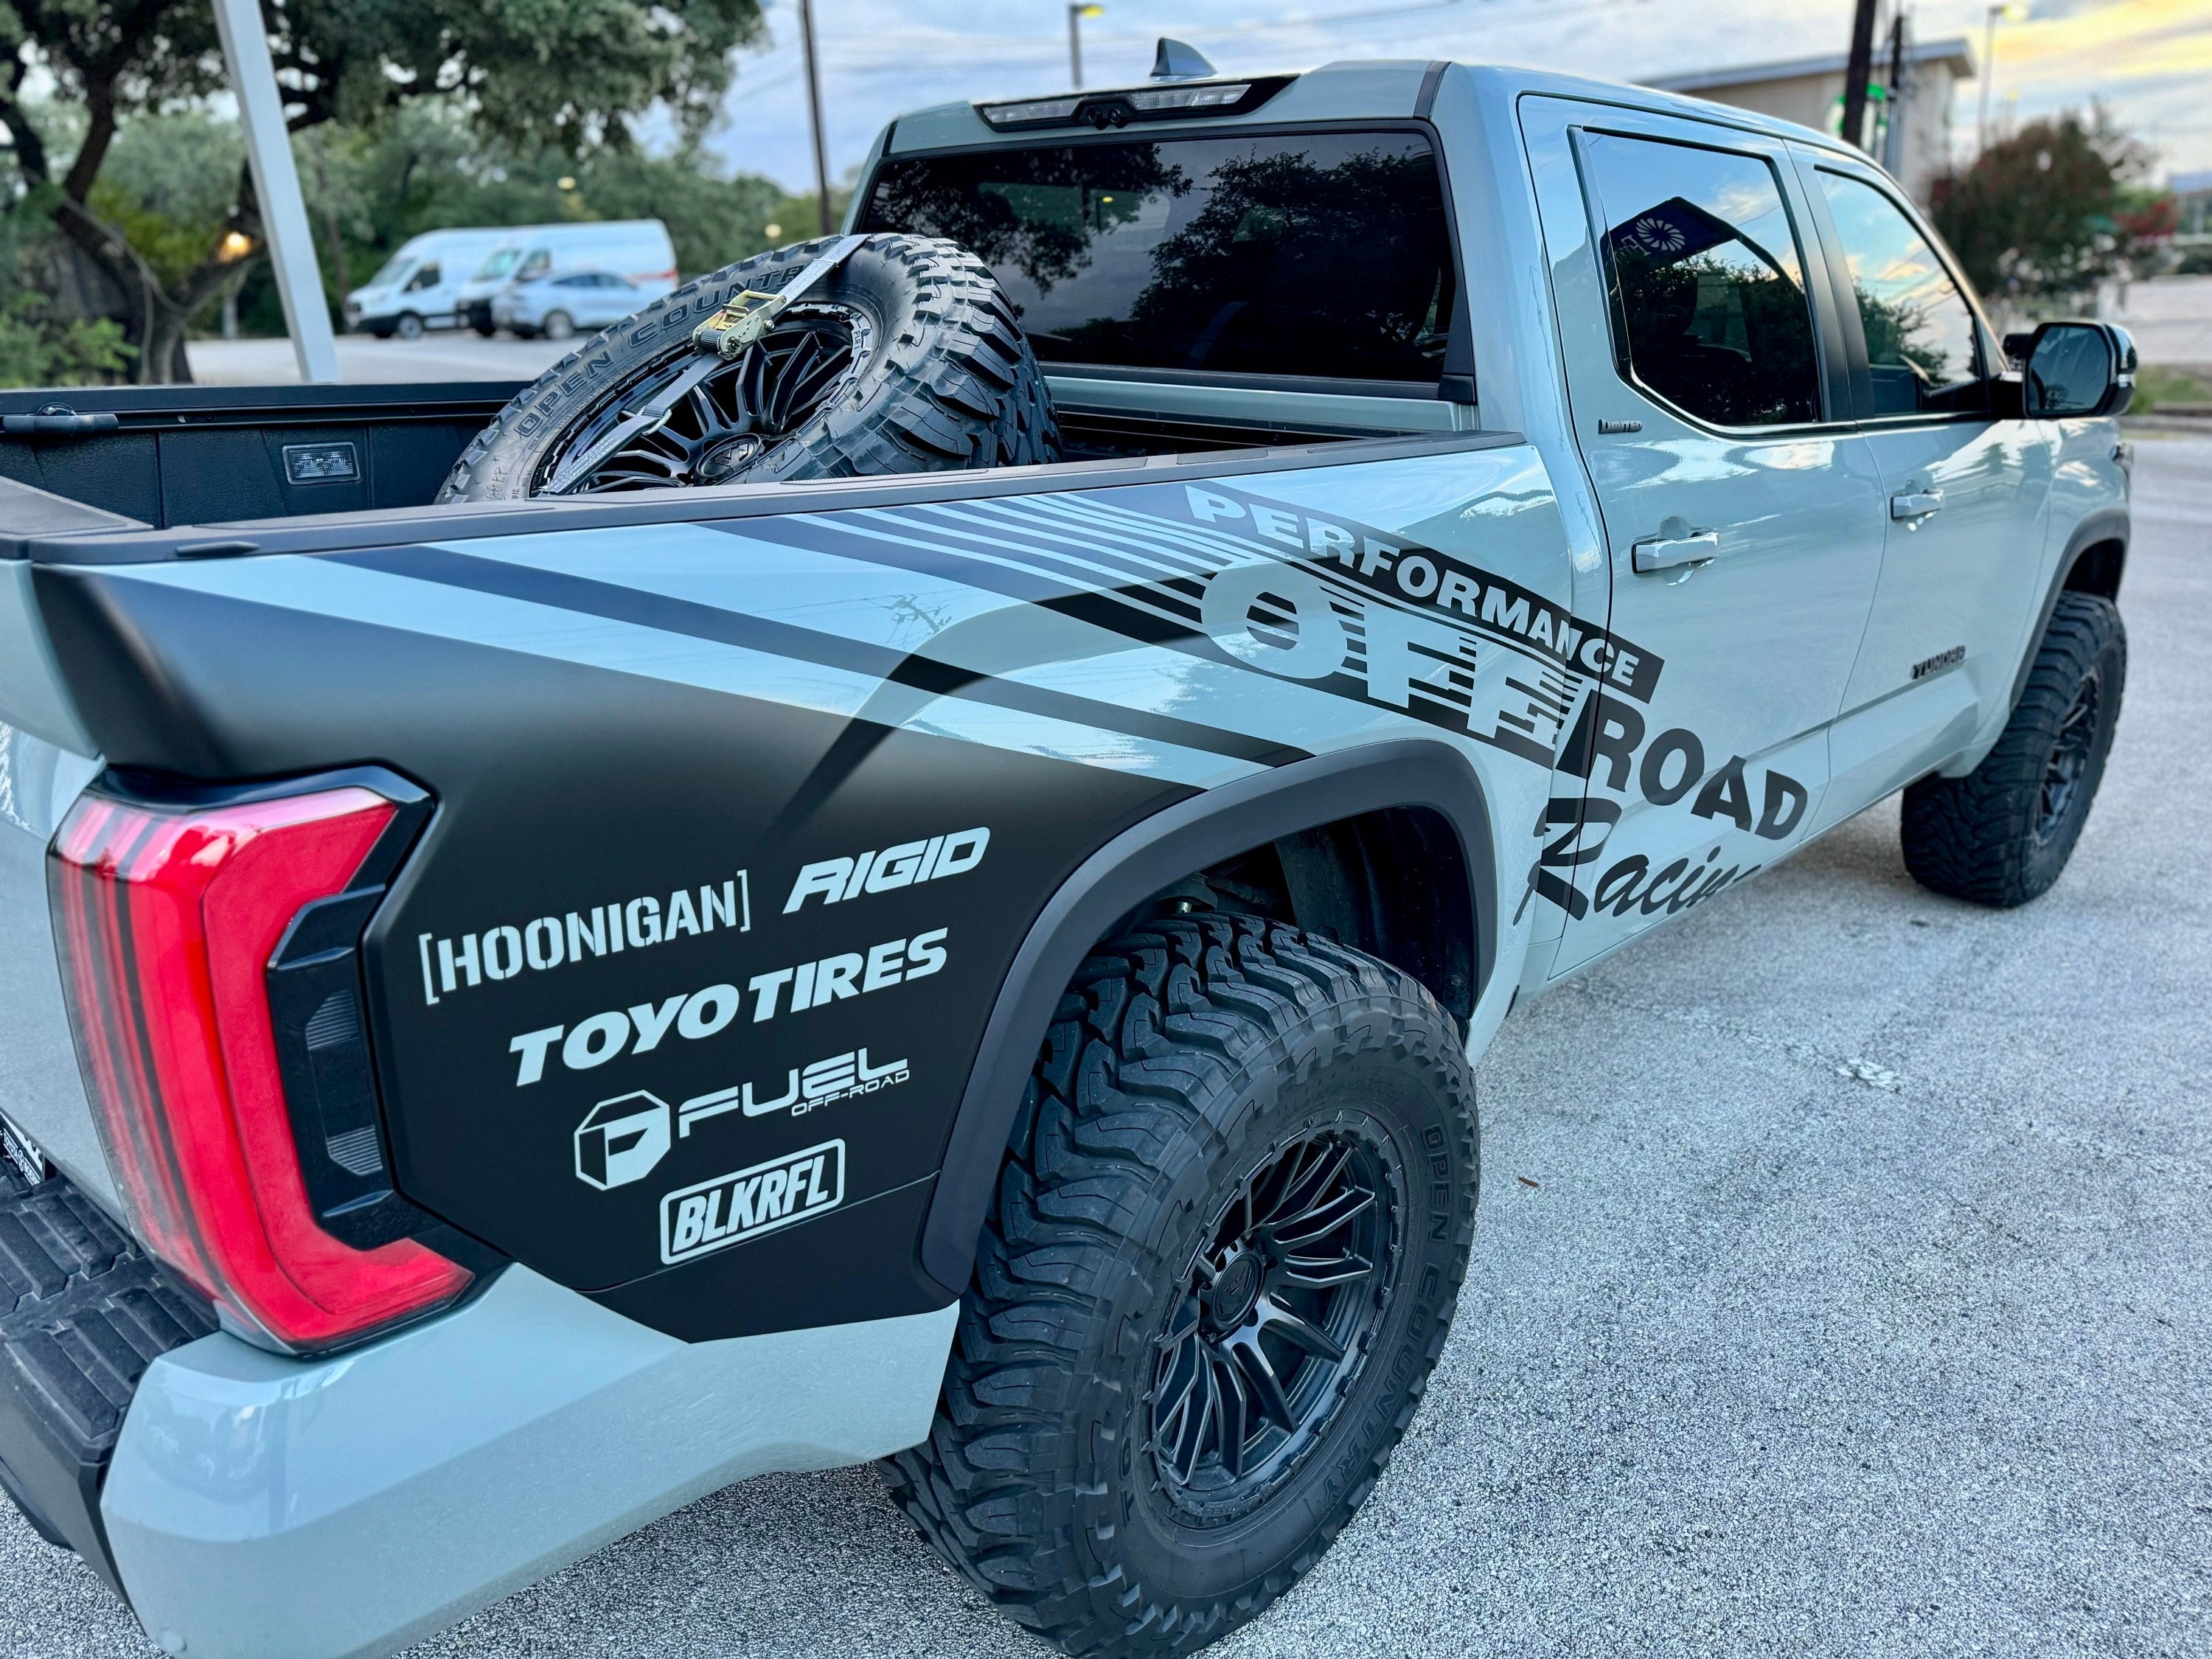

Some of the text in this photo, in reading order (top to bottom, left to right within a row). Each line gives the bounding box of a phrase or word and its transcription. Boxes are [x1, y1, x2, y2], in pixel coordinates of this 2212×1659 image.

[514, 265, 806, 437] OPEN COUNTR
[1185, 484, 1641, 687] PERFORMANCE
[1557, 687, 1809, 842] ROAD
[782, 827, 991, 914] RIGID
[1513, 797, 1762, 927] Racin
[509, 927, 948, 1087] TOYO TIRES
[678, 1047, 908, 1138] FUEL
[791, 1069, 910, 1117] OFF-ROAD
[672, 1154, 829, 1253] BLKRFL
[1324, 1123, 1453, 1504] OPEN COUNTRY
